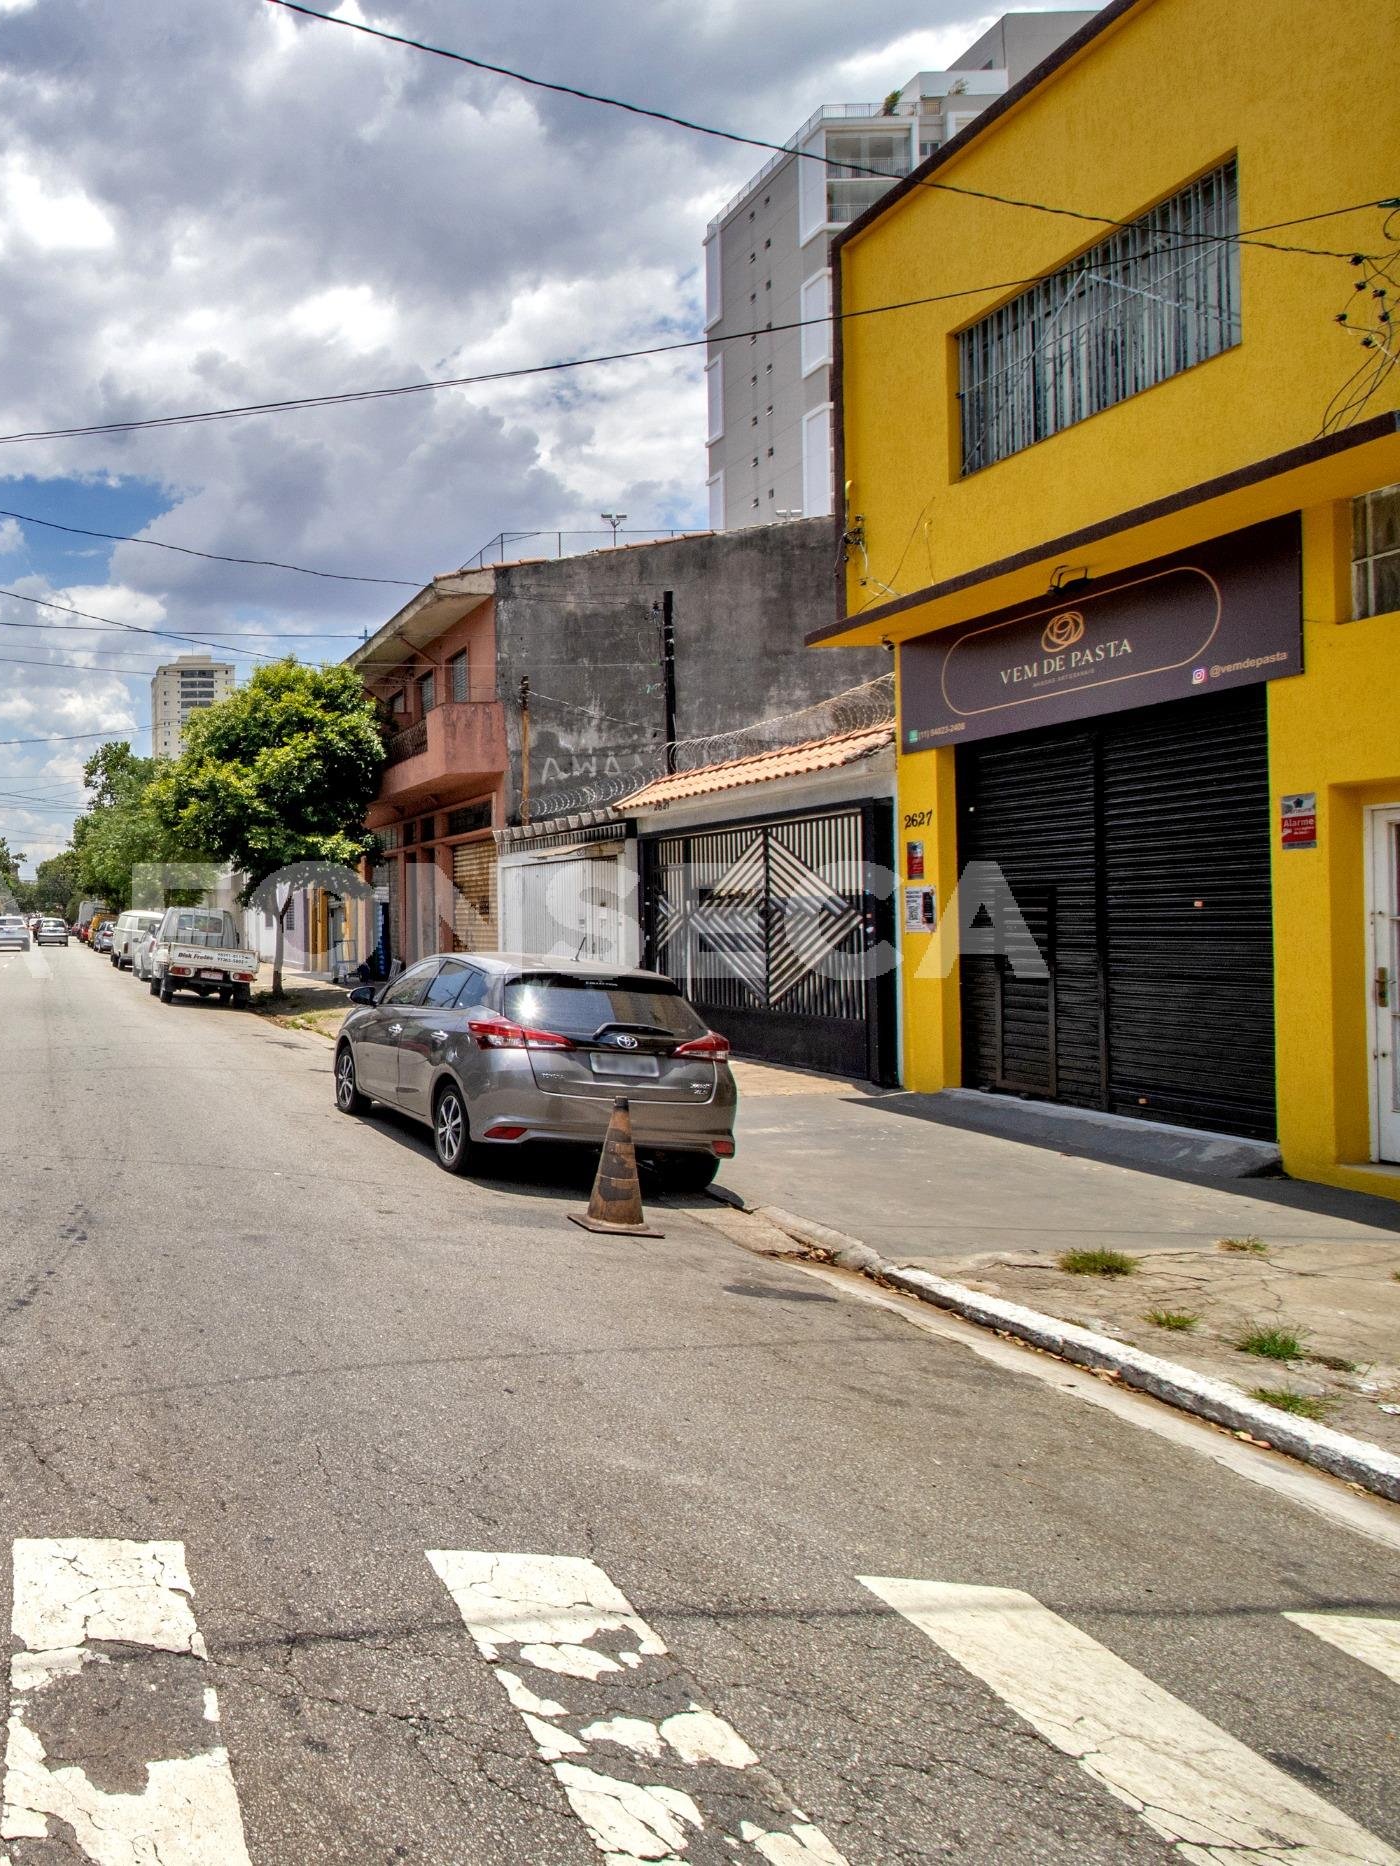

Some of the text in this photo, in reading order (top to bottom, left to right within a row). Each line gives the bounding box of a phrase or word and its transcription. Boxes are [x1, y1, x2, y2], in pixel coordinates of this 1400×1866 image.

[1000, 638, 1133, 684] VEM DE PASTA
[1209, 651, 1289, 678] @vemdepasta
[904, 809, 933, 830] 2627
[1284, 818, 1315, 827] Alarme
